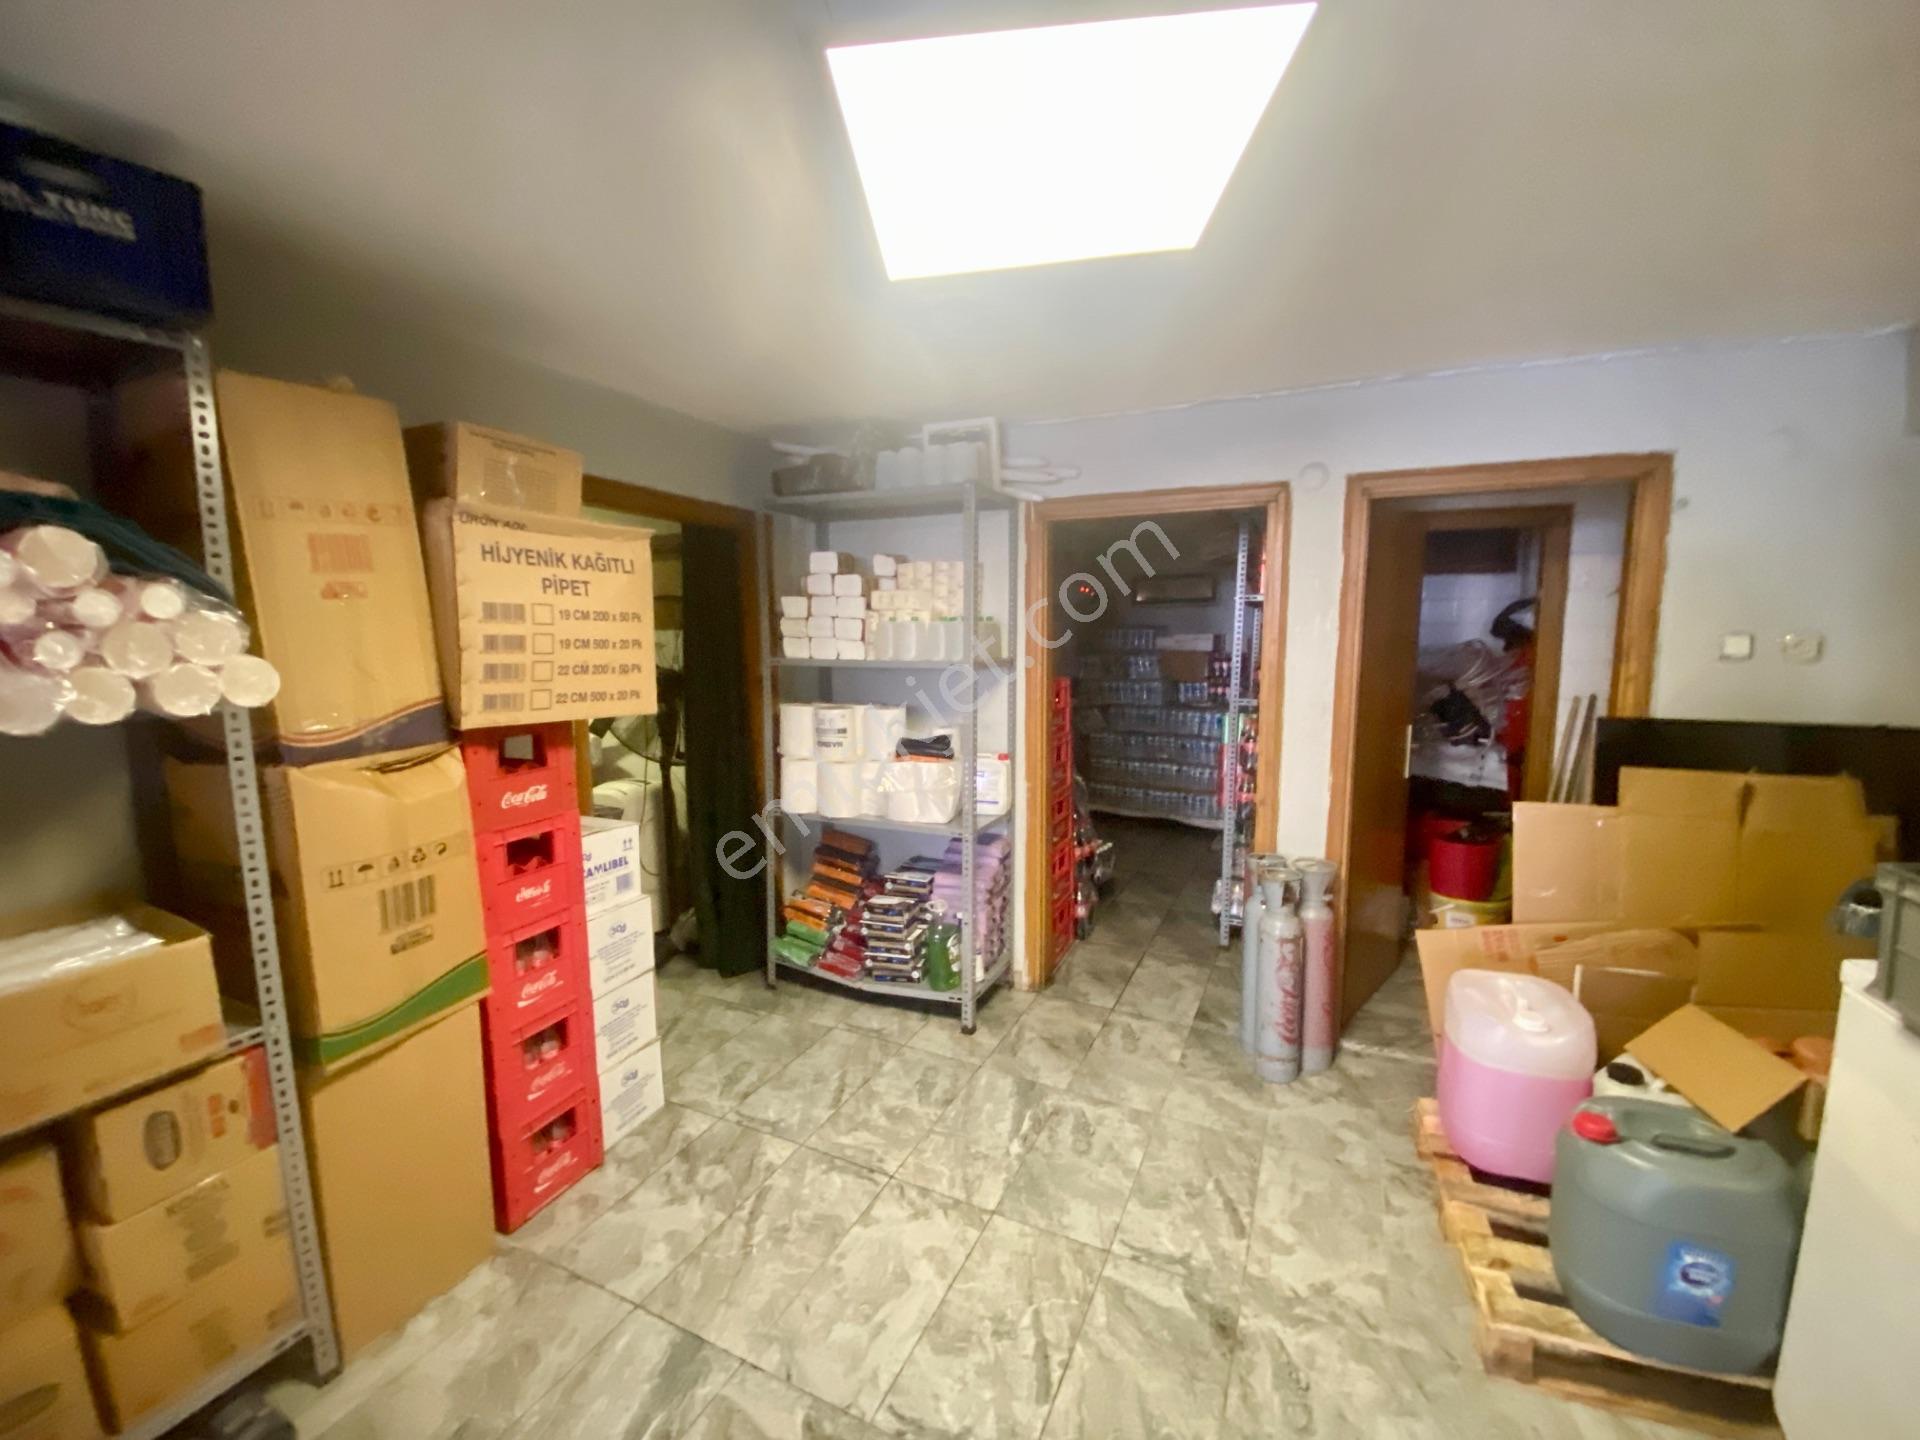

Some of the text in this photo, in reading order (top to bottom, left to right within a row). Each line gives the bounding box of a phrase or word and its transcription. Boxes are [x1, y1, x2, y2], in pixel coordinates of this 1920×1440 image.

[480, 541, 635, 574] HİJYENİK KAĞITLI
[542, 574, 591, 597] PİPET
[559, 609, 571, 620] 19
[573, 609, 590, 620] CM
[559, 638, 571, 649] 19
[573, 638, 590, 650] CM
[557, 665, 569, 676] 22
[572, 664, 589, 675] CM
[555, 692, 568, 704] 22
[570, 692, 587, 703] CM
[583, 856, 629, 878] AMLIBEL
